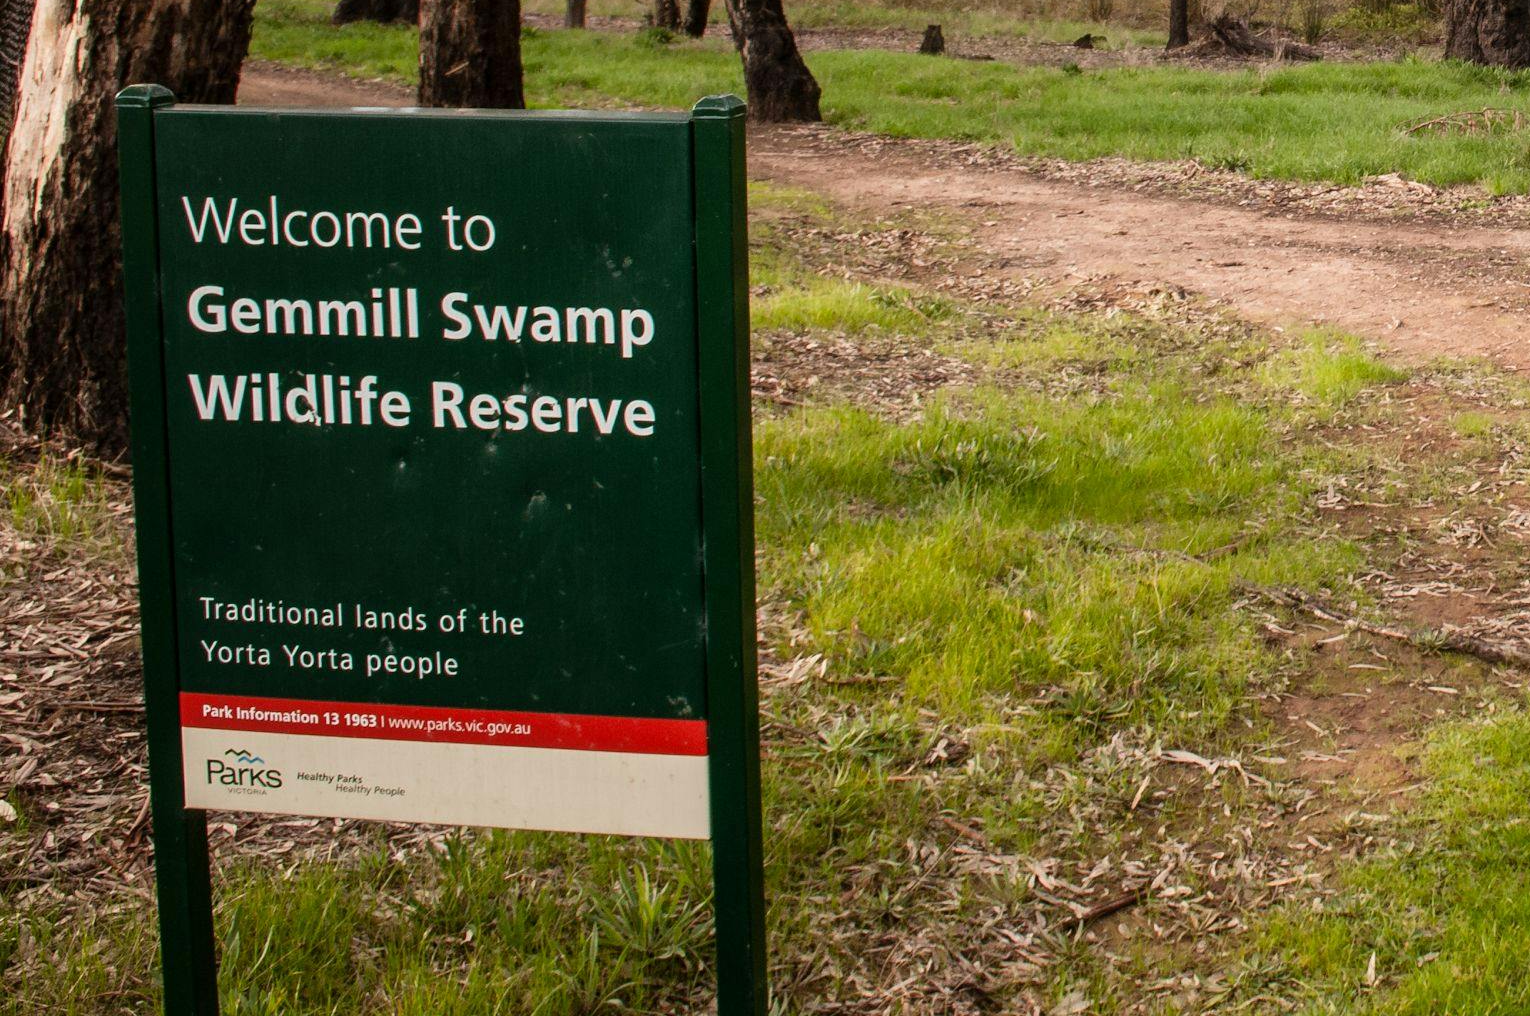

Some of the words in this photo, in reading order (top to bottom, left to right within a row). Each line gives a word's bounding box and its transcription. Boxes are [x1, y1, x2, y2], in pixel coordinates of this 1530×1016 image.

[183, 196, 422, 249] Welcome
[442, 205, 495, 252] to
[188, 286, 418, 338] Gemmill
[442, 292, 654, 358] Swamp
[189, 374, 410, 427] Wildlife
[432, 382, 656, 436] Reserve
[200, 597, 343, 627] Traditional
[355, 604, 427, 632] lands
[440, 608, 467, 633] of
[480, 610, 524, 636] the
[201, 641, 271, 667] Yorta
[283, 645, 353, 672] Yorta
[367, 649, 458, 679] people
[203, 704, 233, 719] Park
[236, 707, 319, 724] Information
[323, 712, 340, 726] 13
[344, 713, 377, 728] 1963
[388, 716, 531, 735] www.parks.vic.gov.au
[207, 759, 283, 789] Parks
[228, 786, 268, 796] VICTORIA
[297, 771, 334, 784] Healthy
[337, 775, 363, 785] Parks
[336, 783, 371, 796] Healthy
[374, 786, 405, 797] People
